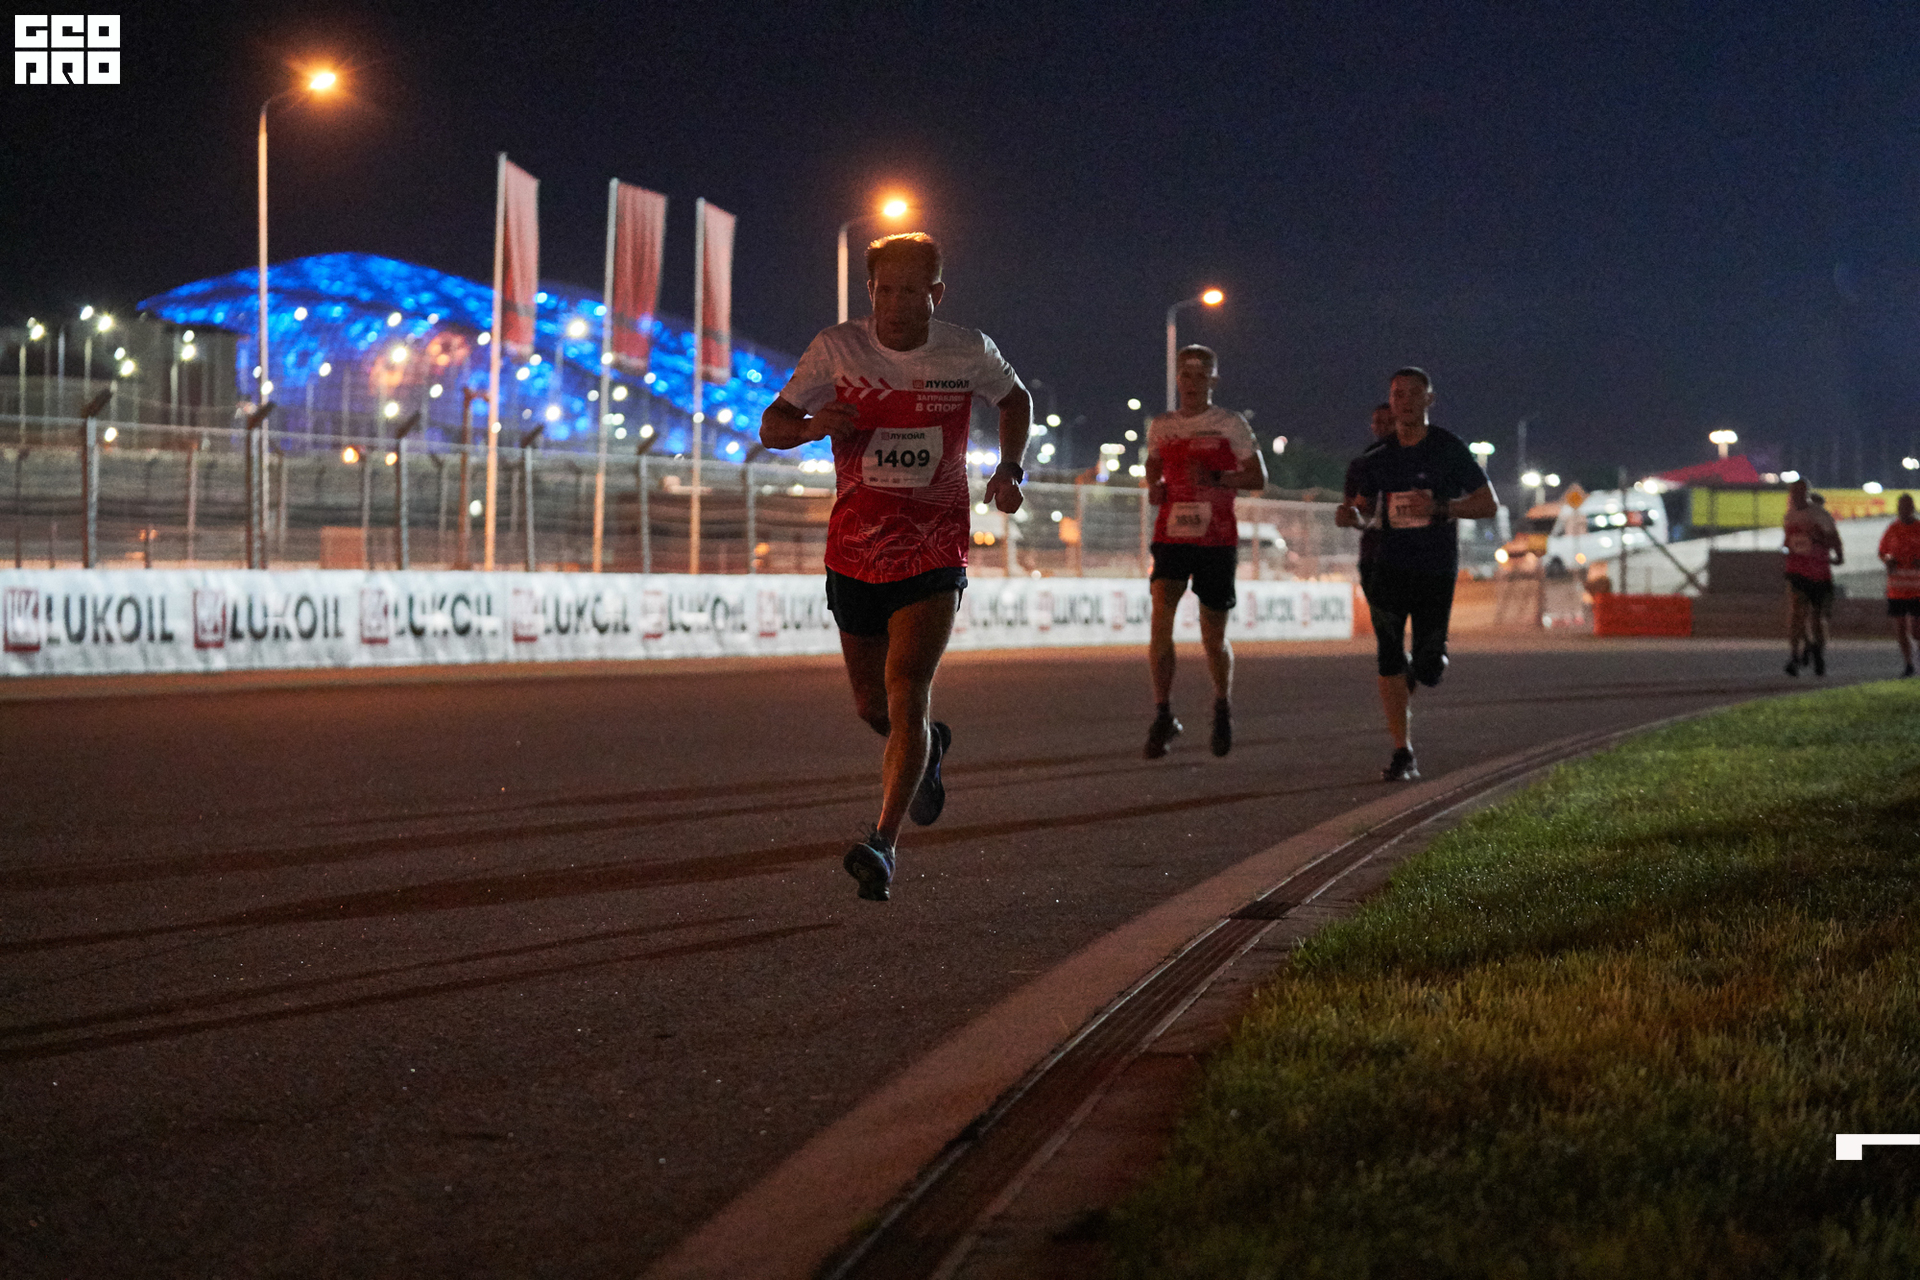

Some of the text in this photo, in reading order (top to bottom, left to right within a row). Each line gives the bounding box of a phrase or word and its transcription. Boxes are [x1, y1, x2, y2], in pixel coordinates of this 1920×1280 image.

[925, 379, 970, 389] ЛУКОЙЛ
[915, 402, 924, 412] В
[890, 432, 925, 440] ЛУКОЙЛ
[874, 449, 930, 468] 1409
[46, 592, 174, 645] LUKOIL
[231, 594, 344, 639] LUKOIL
